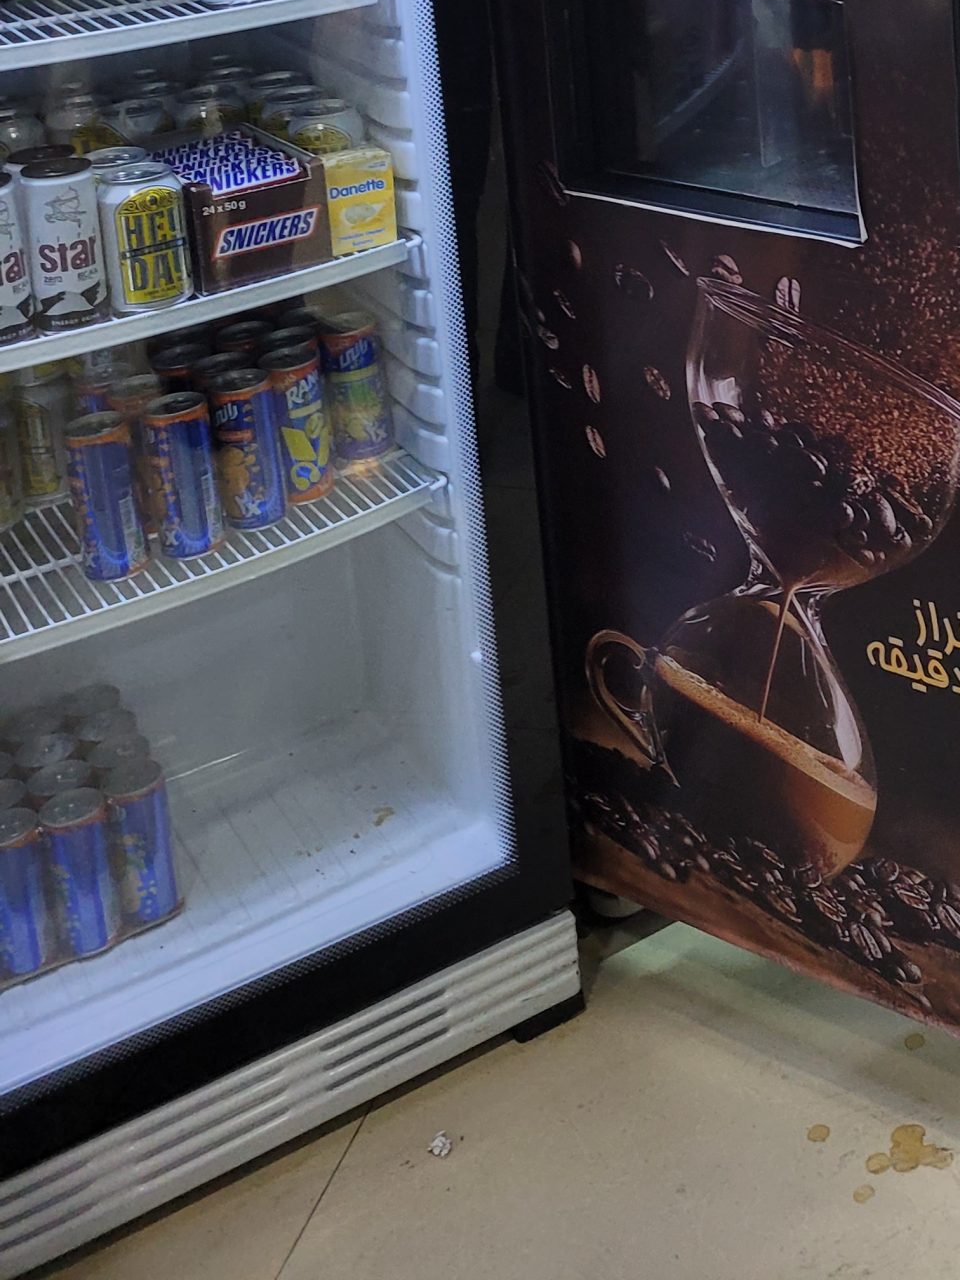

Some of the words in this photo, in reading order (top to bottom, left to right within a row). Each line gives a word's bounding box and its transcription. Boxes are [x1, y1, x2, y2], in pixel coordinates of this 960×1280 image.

[208, 159, 297, 193] NICKERS
[329, 179, 385, 200] Danette
[202, 206, 215, 216] 24
[224, 201, 238, 212] 50
[239, 200, 246, 210] g
[220, 211, 315, 255] SNICKERS
[285, 372, 319, 409] RAN
